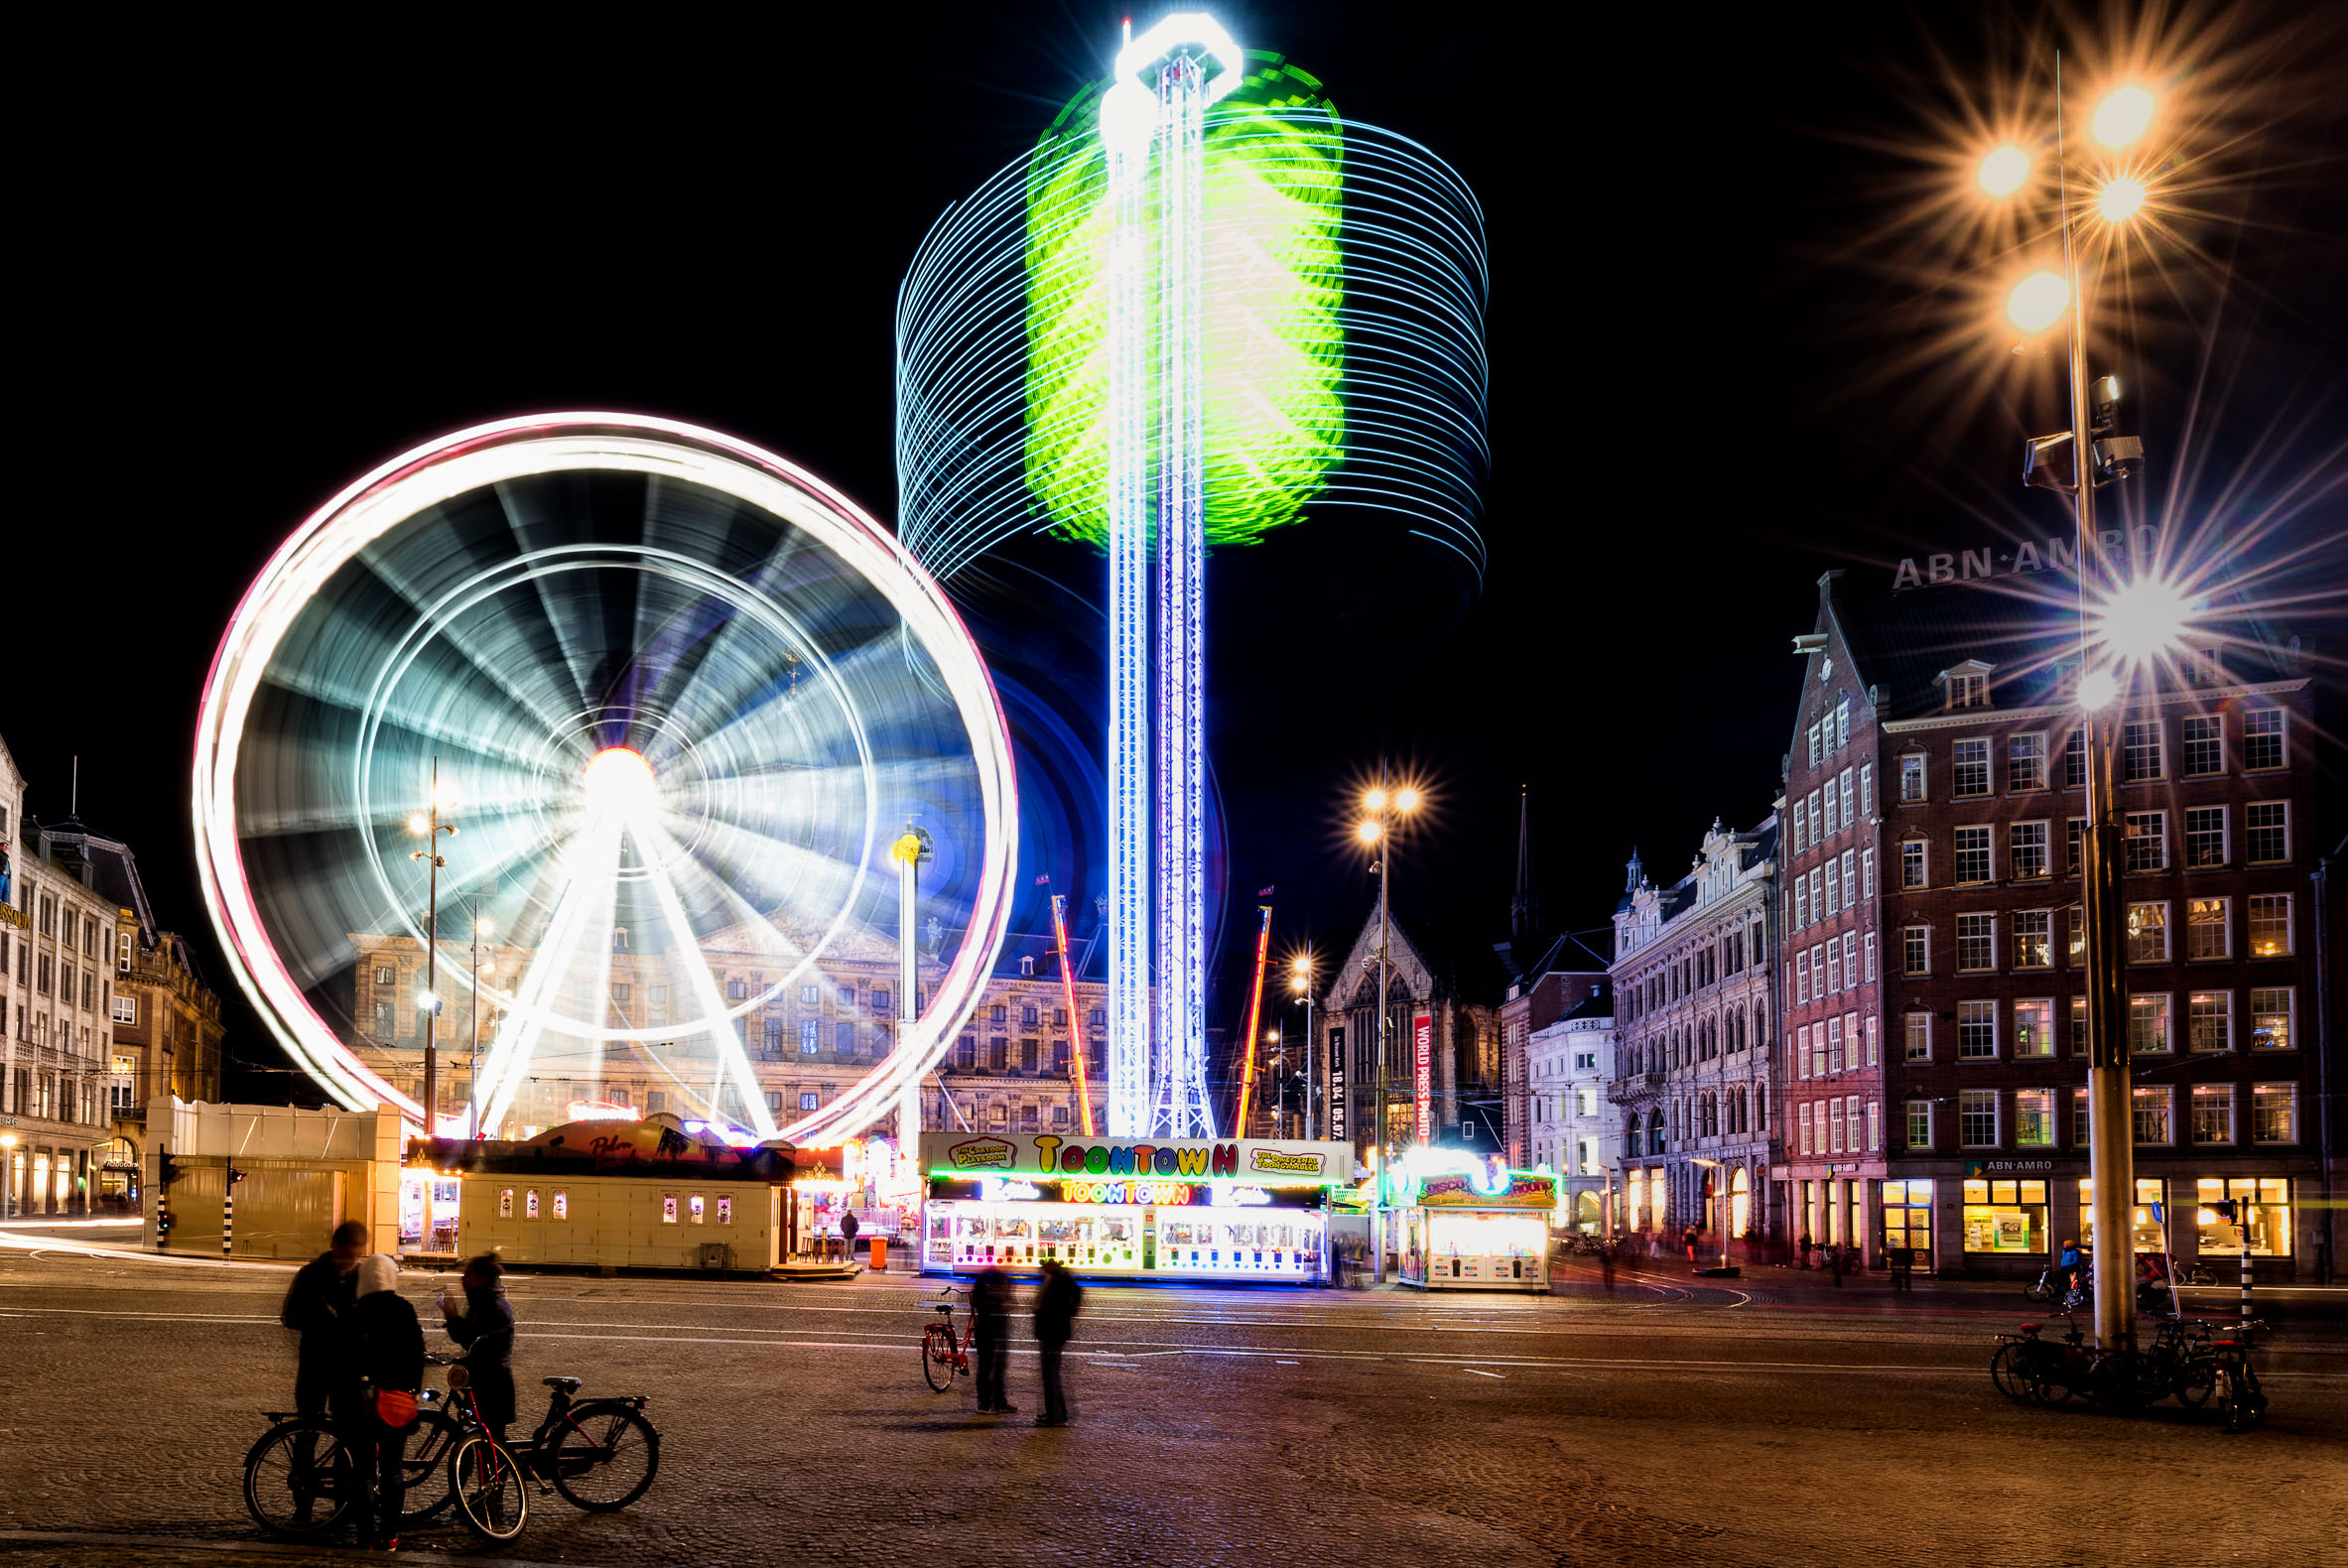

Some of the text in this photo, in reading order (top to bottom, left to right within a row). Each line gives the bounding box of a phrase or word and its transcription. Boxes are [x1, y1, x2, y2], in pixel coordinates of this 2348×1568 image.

[1417, 1026, 1430, 1136] WORLD PRESS PHOTO
[1332, 1071, 1344, 1141] 18.04 05.07.
[957, 1153, 1006, 1164] PLAYROOM
[969, 1145, 1007, 1155] CARTOON
[1033, 1134, 1239, 1179] TOONTOWN
[1256, 1159, 1318, 1171] TOONGAMBLER
[1271, 1154, 1318, 1165] ORIGINAL
[1061, 1180, 1190, 1205] TOONTOWN
